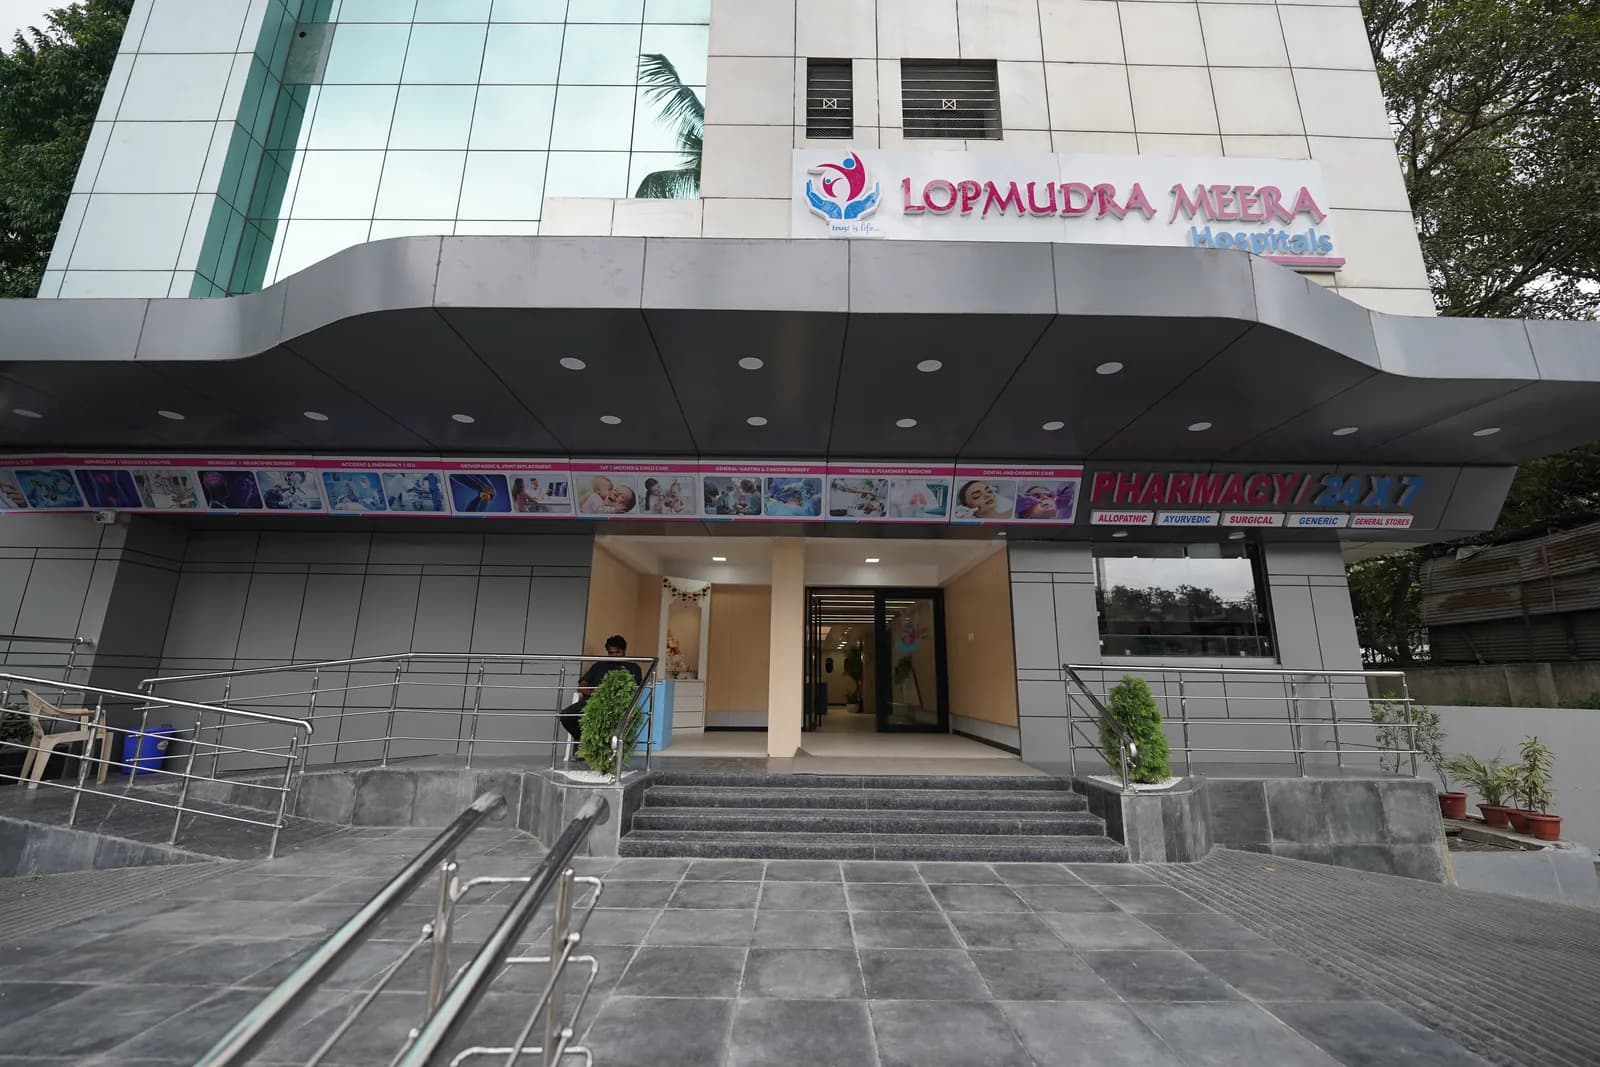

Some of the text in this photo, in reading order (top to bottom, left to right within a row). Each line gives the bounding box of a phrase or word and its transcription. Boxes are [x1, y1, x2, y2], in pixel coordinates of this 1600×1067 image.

[902, 177, 1328, 225] LOPMUDRA MEERA
[1189, 225, 1334, 254] Hospitals
[1097, 513, 1148, 523] ALLOPATHIC
[1162, 514, 1212, 524] AYURVEDIC
[1229, 515, 1273, 525] SURGICAL
[1298, 516, 1339, 526] GENERIC
[1354, 518, 1410, 527] GENERAL STORES
